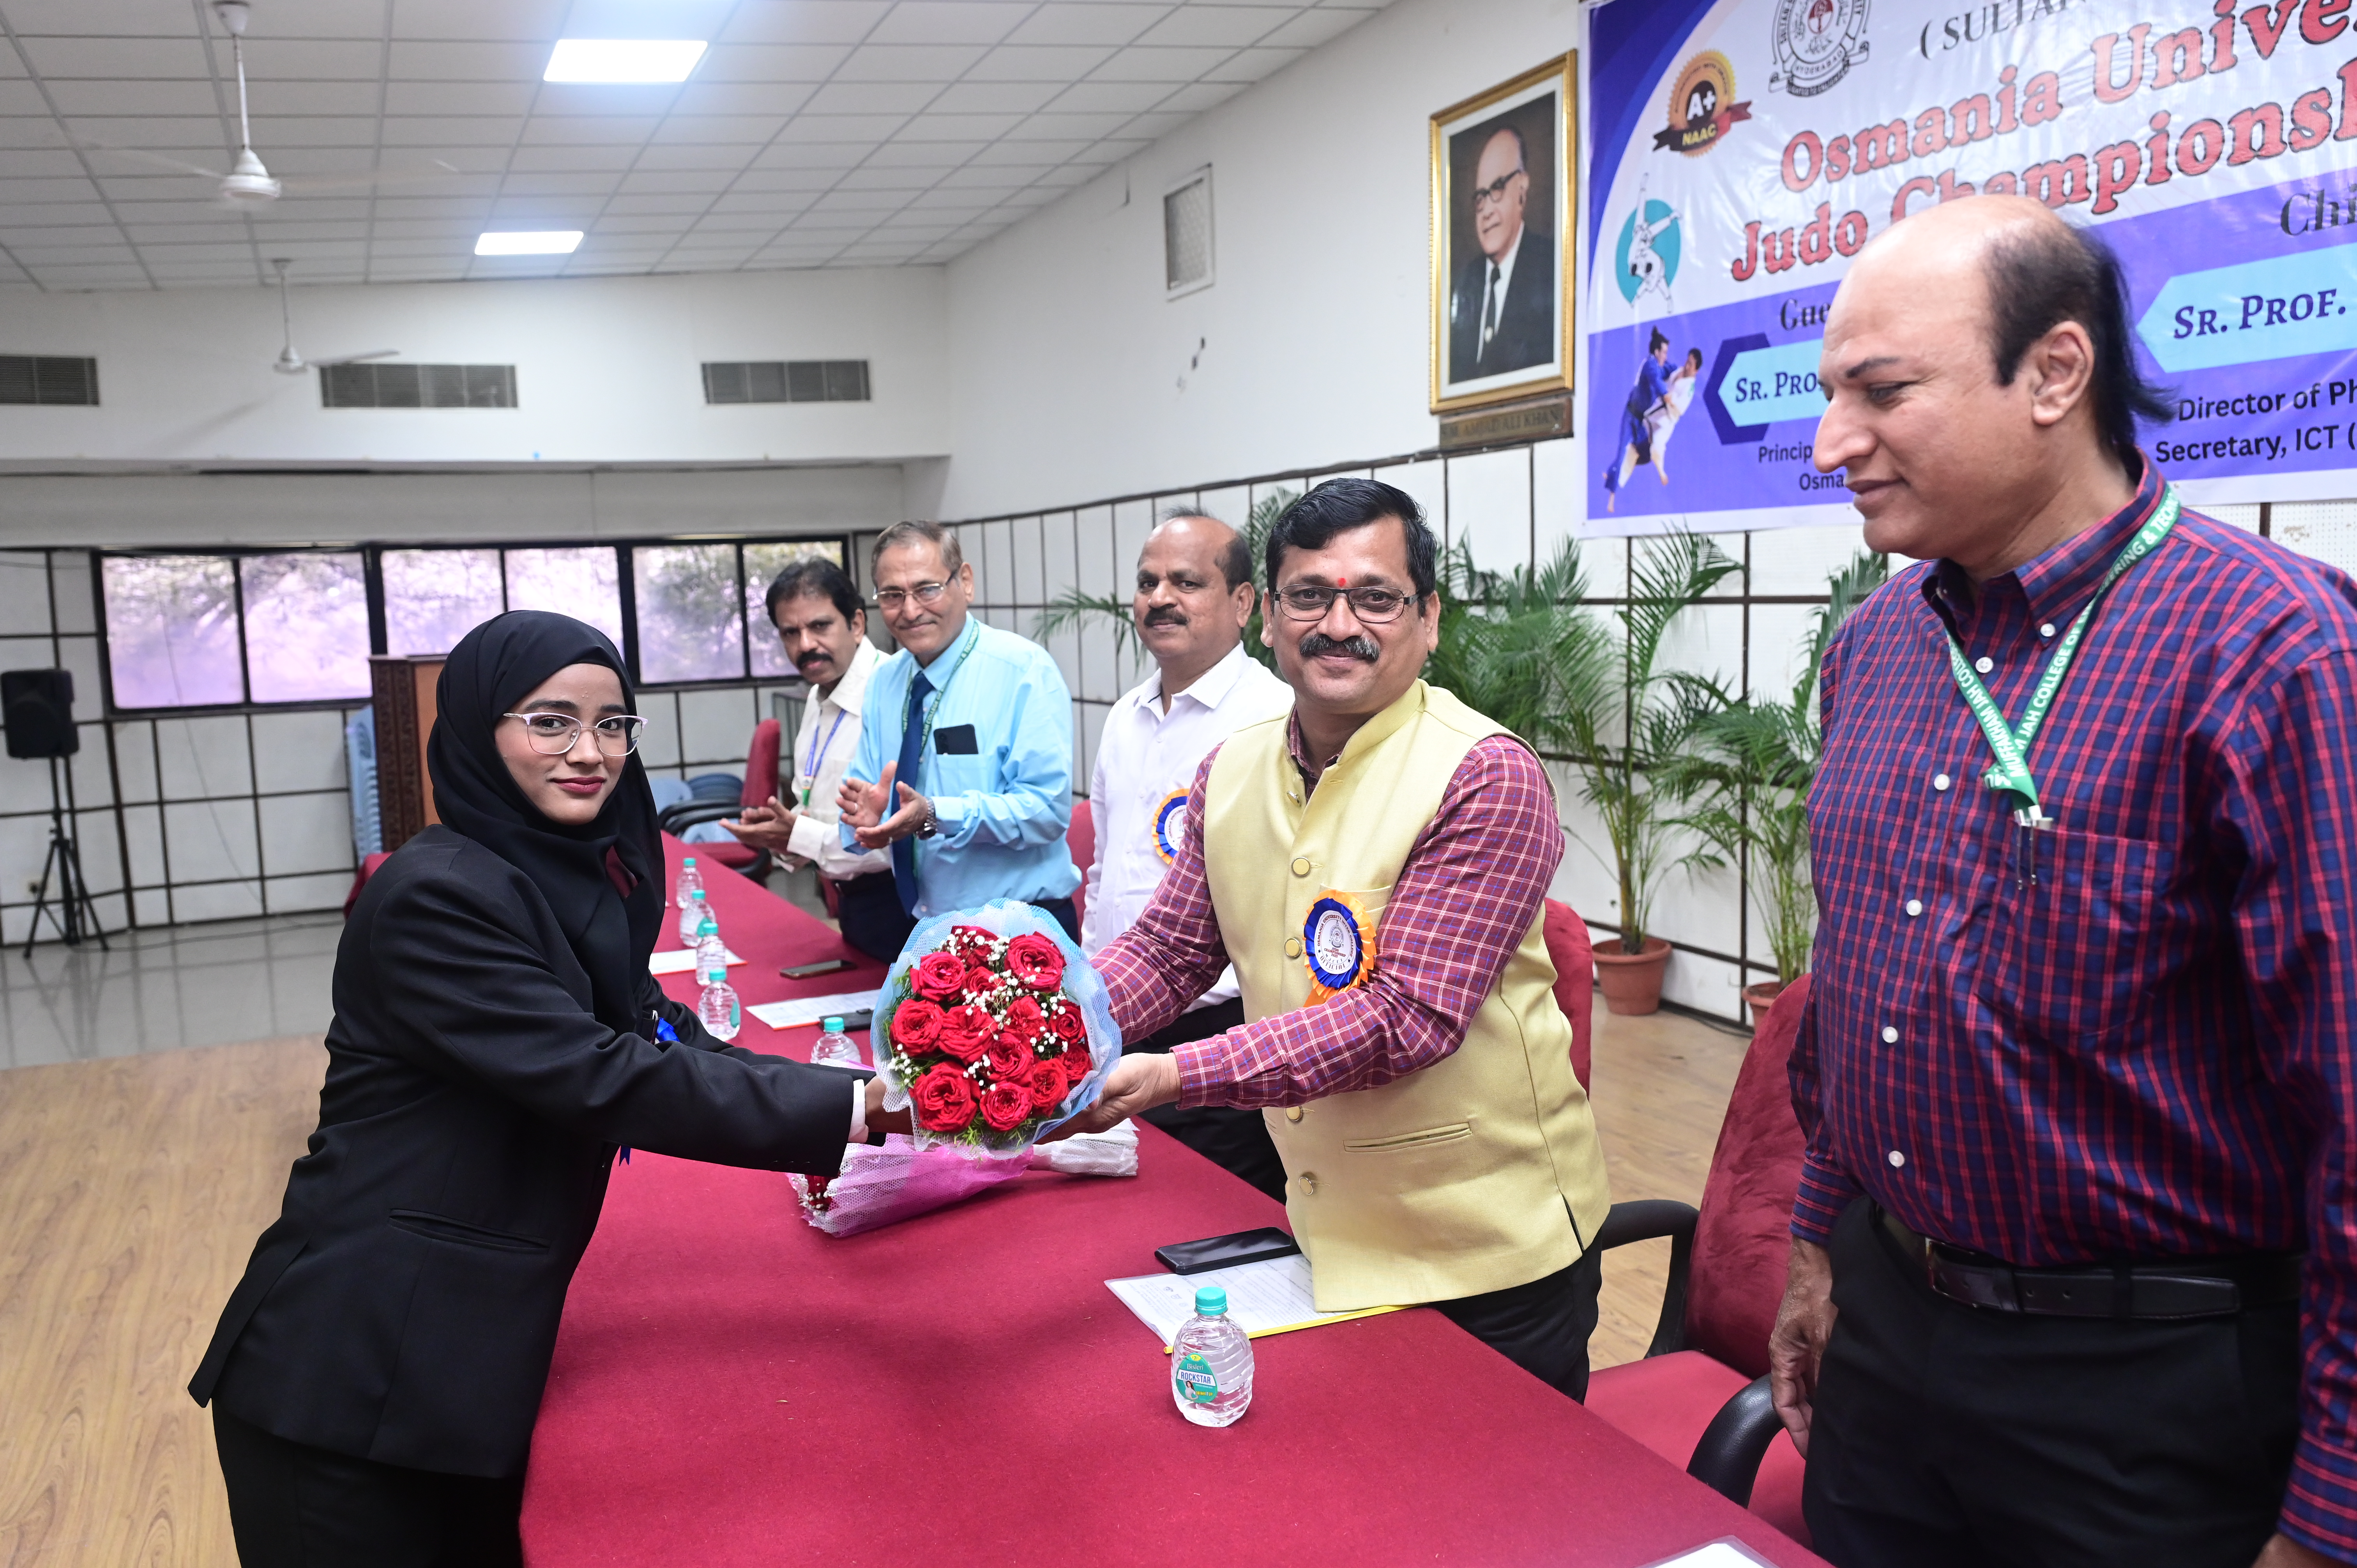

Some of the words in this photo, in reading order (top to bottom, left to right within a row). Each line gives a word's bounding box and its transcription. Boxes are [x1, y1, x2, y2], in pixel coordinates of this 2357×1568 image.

[1686, 90, 1716, 120] A+
[1781, 64, 2063, 192] Osmania
[2090, 0, 2357, 104] Unive
[1682, 123, 1716, 146] NAAC
[1731, 201, 1868, 281] Judo
[2173, 305, 2228, 339] SR.
[2239, 289, 2346, 330] PROF.
[1774, 372, 1822, 397] PRO
[2179, 393, 2285, 422] Director
[2293, 382, 2321, 409] of
[1758, 441, 1813, 463] Princip
[2156, 435, 2287, 462] Secretary,
[2296, 425, 2339, 452] ICT
[1799, 473, 1844, 491] Osma
[2019, 710, 2041, 738] JAH
[2033, 648, 2071, 708] COLLEGE
[2141, 530, 2158, 545] &
[1967, 684, 1989, 709] JAH
[1980, 706, 2026, 777] MUFFAKHAM
[1323, 914, 1341, 923] UNIVERSITY
[1320, 955, 1346, 970] OFFICIAL
[1181, 1372, 1211, 1384] ROCKSTAR
